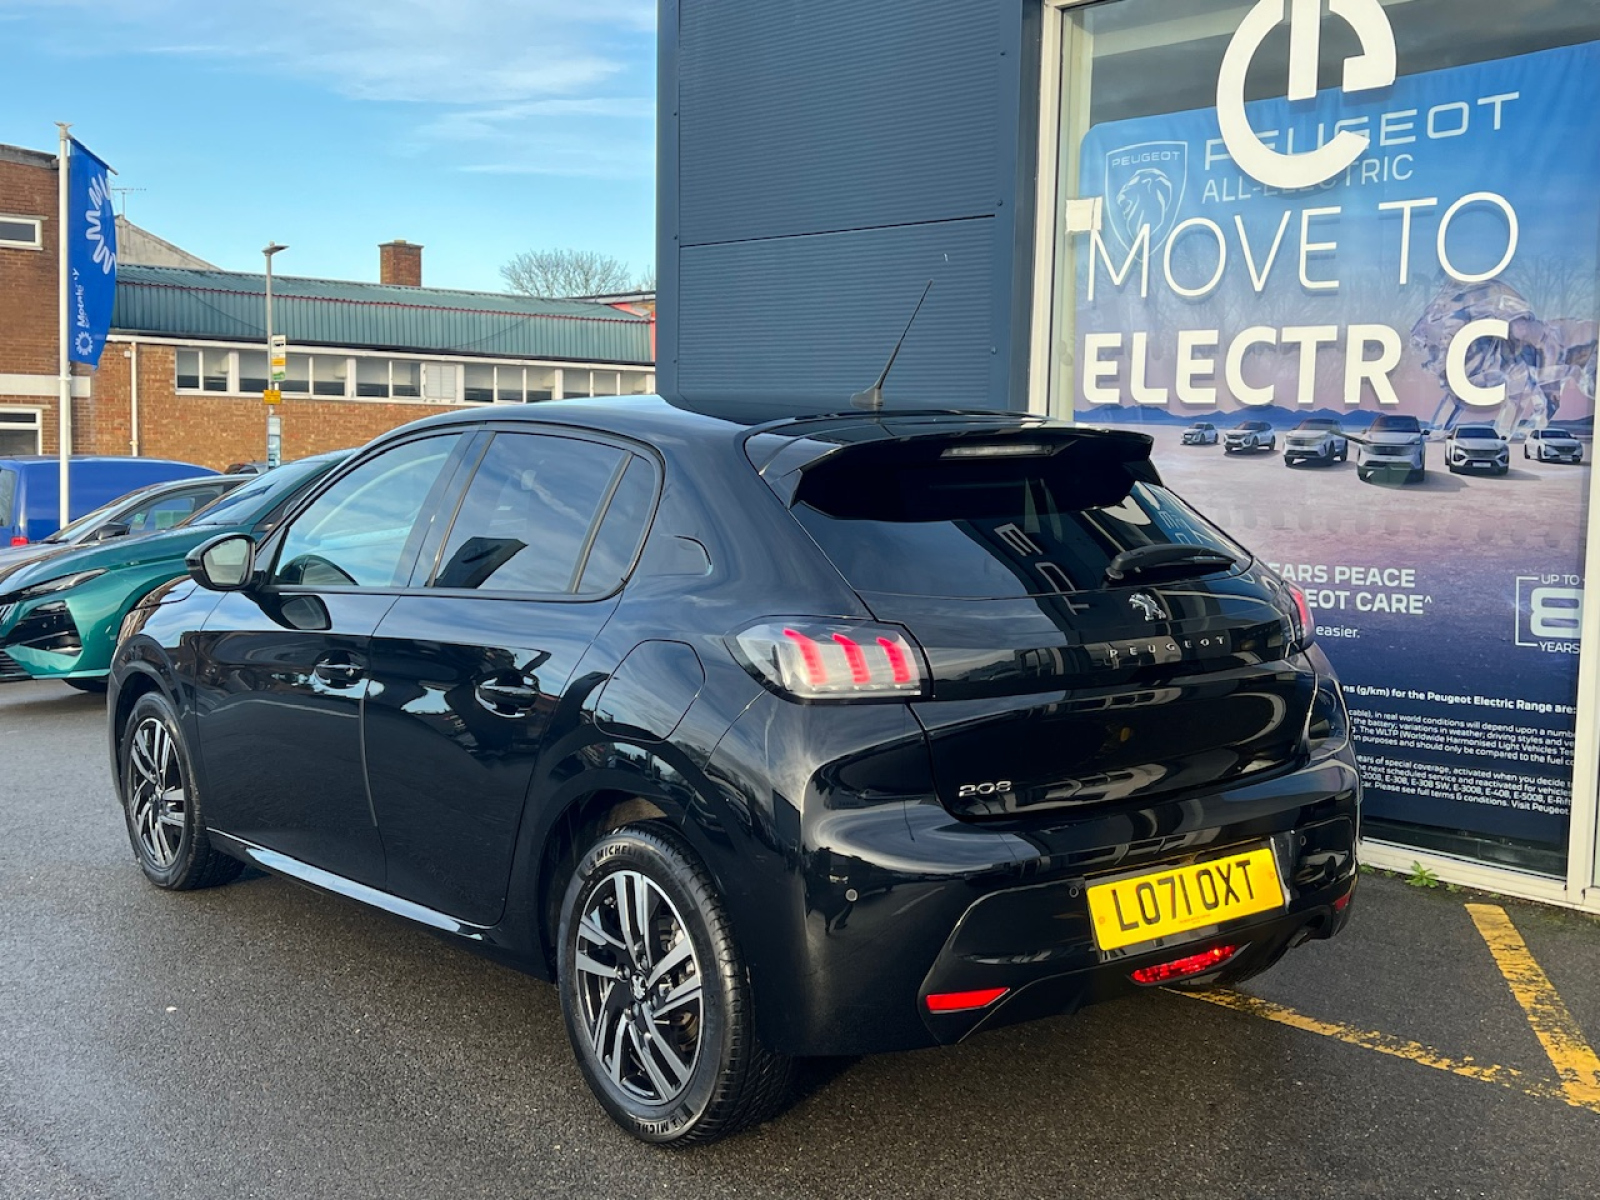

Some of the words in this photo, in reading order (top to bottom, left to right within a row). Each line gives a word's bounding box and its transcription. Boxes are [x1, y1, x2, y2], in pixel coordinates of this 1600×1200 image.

[1111, 150, 1181, 168] PEUGEOT
[1087, 206, 1342, 301] MOVE
[1379, 191, 1519, 284] TO
[1334, 566, 1416, 588] PEACE
[1540, 574, 1560, 584] UP
[1562, 574, 1580, 586] TO
[1530, 587, 1584, 639] 8
[1315, 624, 1361, 639] easier.
[1109, 635, 1226, 658] PEUGEOT
[1539, 641, 1581, 655] YEARS
[1356, 684, 1390, 697] (g/km)
[1391, 687, 1406, 697] for
[1408, 689, 1425, 699] the
[1427, 691, 1472, 704] Peugeot
[1474, 695, 1514, 708] Electric
[1516, 700, 1553, 713] Range
[1374, 710, 1382, 719] in
[1384, 712, 1398, 720] real
[1399, 714, 1421, 723] world
[1422, 717, 1465, 727] conditions
[1466, 720, 1480, 729] will
[1481, 722, 1514, 733] depend
[1515, 727, 1538, 736] upon
[1399, 723, 1439, 733] variations
[1440, 726, 1447, 734] in
[1486, 731, 1516, 744] driving
[1517, 735, 1544, 745] styles
[1545, 738, 1562, 746] and
[1359, 726, 1375, 735] The
[1375, 727, 1399, 737] WLTP
[1399, 730, 1445, 742] (Worldwide
[1446, 735, 1497, 748] Harmonised
[1498, 741, 1520, 752] Light
[1521, 743, 1557, 754] Vehicles
[1362, 737, 1398, 746] purposes
[1416, 741, 1443, 751] should
[1444, 745, 1462, 755] only
[1464, 746, 1474, 754] be
[1475, 749, 1518, 759] compared
[1520, 752, 1529, 761] to
[1530, 753, 1545, 763] the
[1547, 755, 1564, 765] fuel
[1368, 765, 1385, 773] next
[1386, 767, 1427, 779] scheduled
[1428, 773, 1456, 782] service
[1458, 777, 1474, 785] and
[1475, 779, 1523, 791] reactivated
[1524, 784, 1536, 793] for
[1375, 756, 1384, 765] of
[1385, 759, 1412, 768] special
[1413, 763, 1451, 775] coverage,
[1453, 767, 1491, 778] activated
[1493, 771, 1517, 781] when
[1519, 776, 1535, 784] you
[1536, 776, 1565, 786] decide
[958, 780, 1013, 799] 208
[1375, 781, 1400, 792] Please
[1417, 787, 1430, 796] full
[1431, 789, 1455, 799] terms
[1511, 800, 1530, 810] Visit
[1111, 874, 1193, 932] LO71
[1195, 859, 1254, 911] OXT
